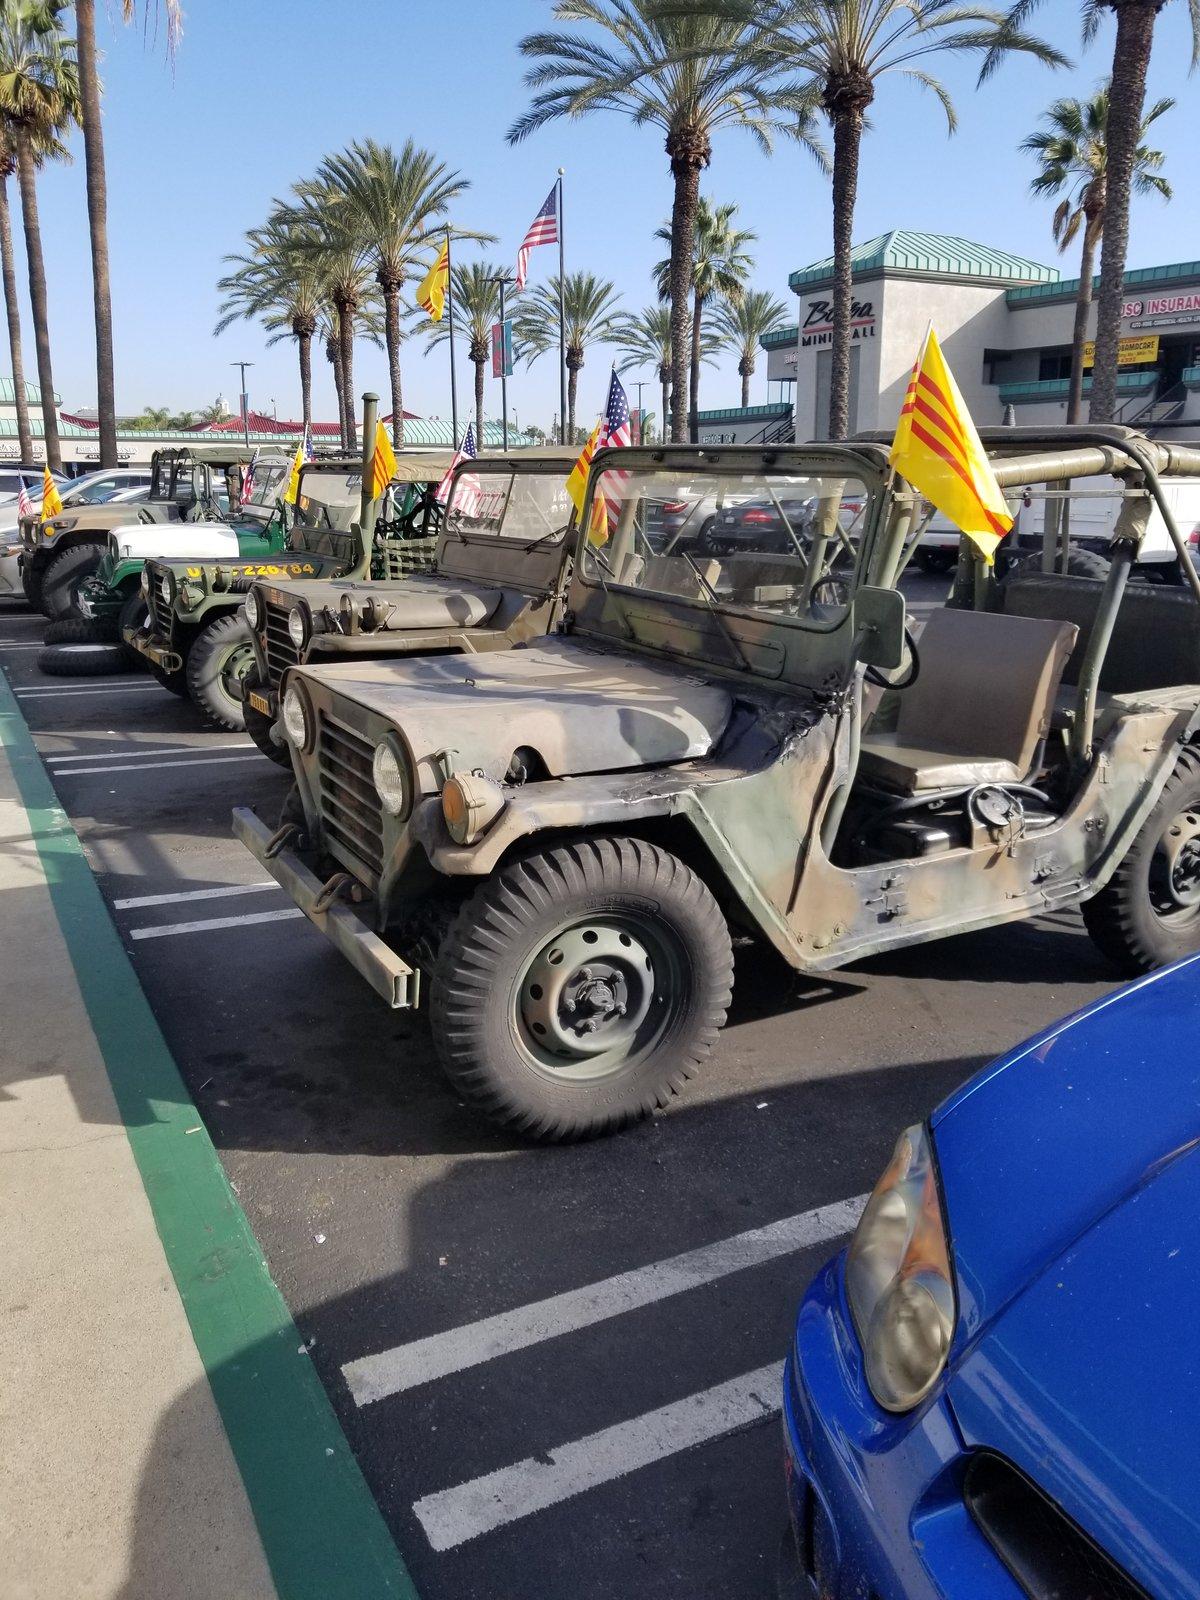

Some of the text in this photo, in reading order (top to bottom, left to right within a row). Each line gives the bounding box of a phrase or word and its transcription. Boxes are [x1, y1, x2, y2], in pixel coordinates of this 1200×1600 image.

[803, 297, 875, 328] Bosa
[802, 326, 875, 346] MINI ALL
